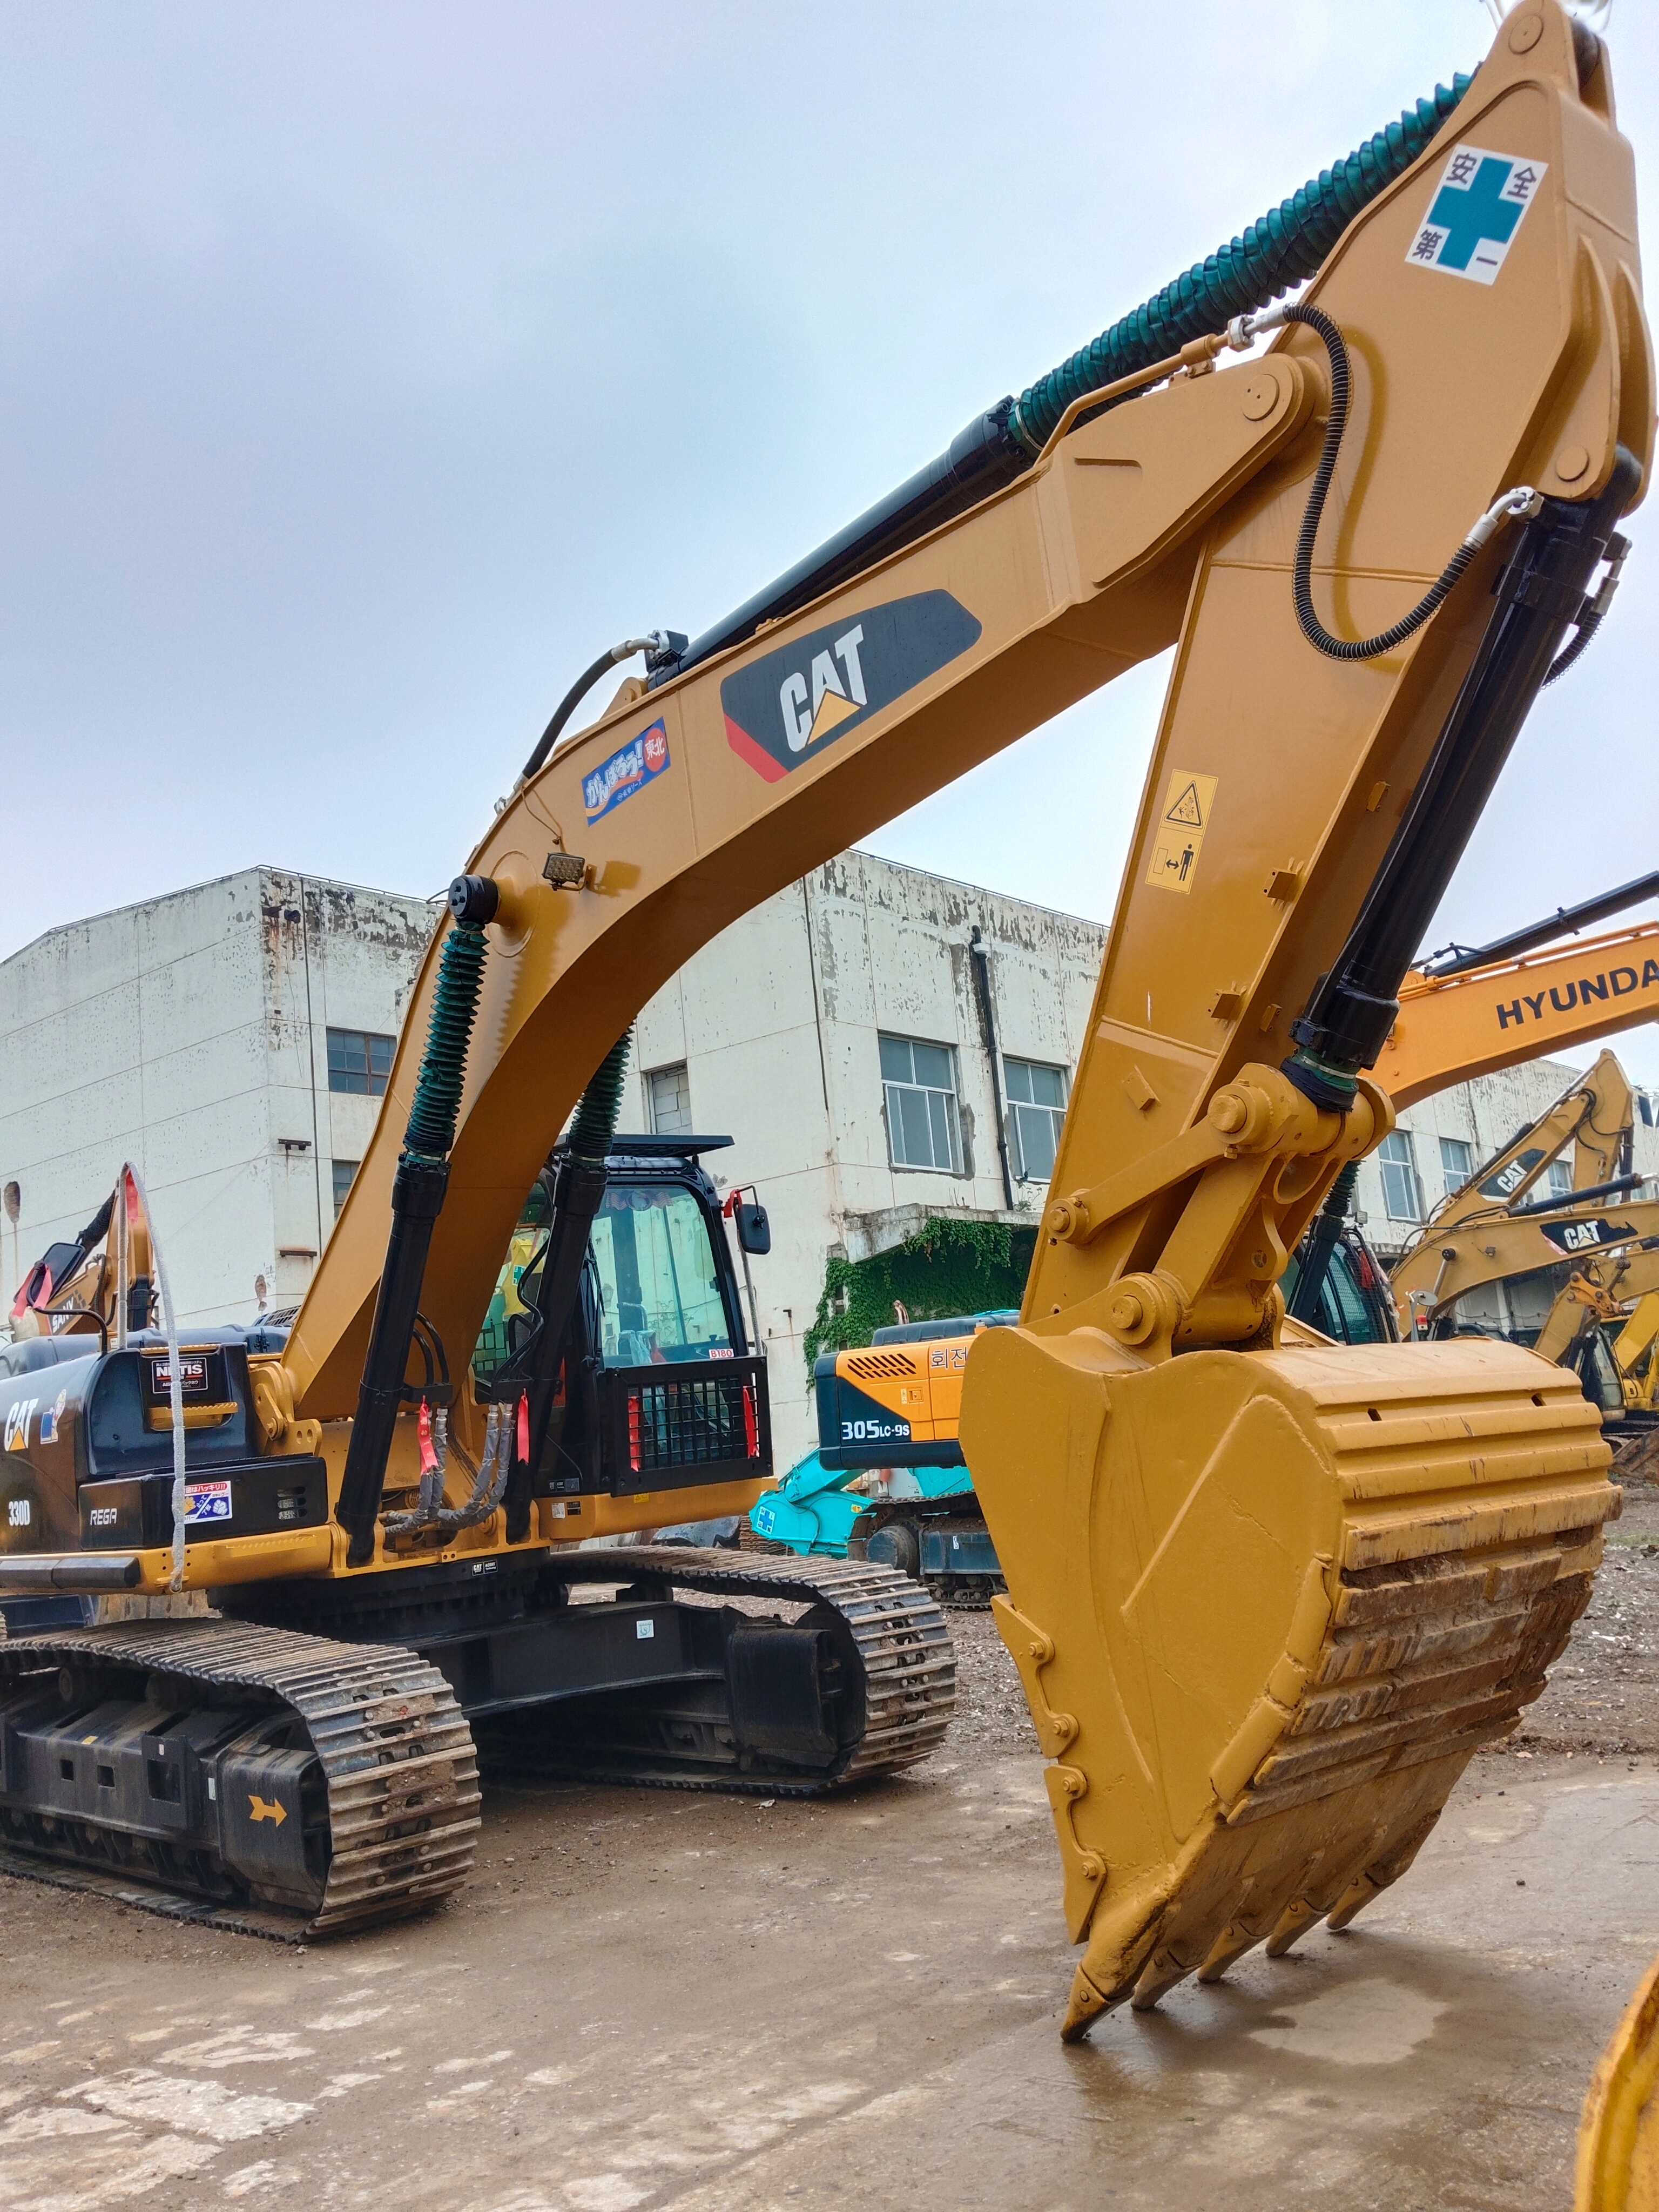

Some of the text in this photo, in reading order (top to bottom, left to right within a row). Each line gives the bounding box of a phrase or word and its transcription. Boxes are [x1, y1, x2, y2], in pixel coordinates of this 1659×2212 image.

[780, 624, 867, 752] CAT
[645, 737, 665, 760] 東北
[1496, 959, 1659, 1029] HYUNDA
[1497, 1159, 1528, 1192] CAT
[1564, 1220, 1601, 1250] CAT
[711, 1350, 732, 1358] B180
[930, 1346, 967, 1369] 회전
[4, 1398, 39, 1451] CAT
[8, 1500, 30, 1526] 330D
[90, 1508, 117, 1526] REGA
